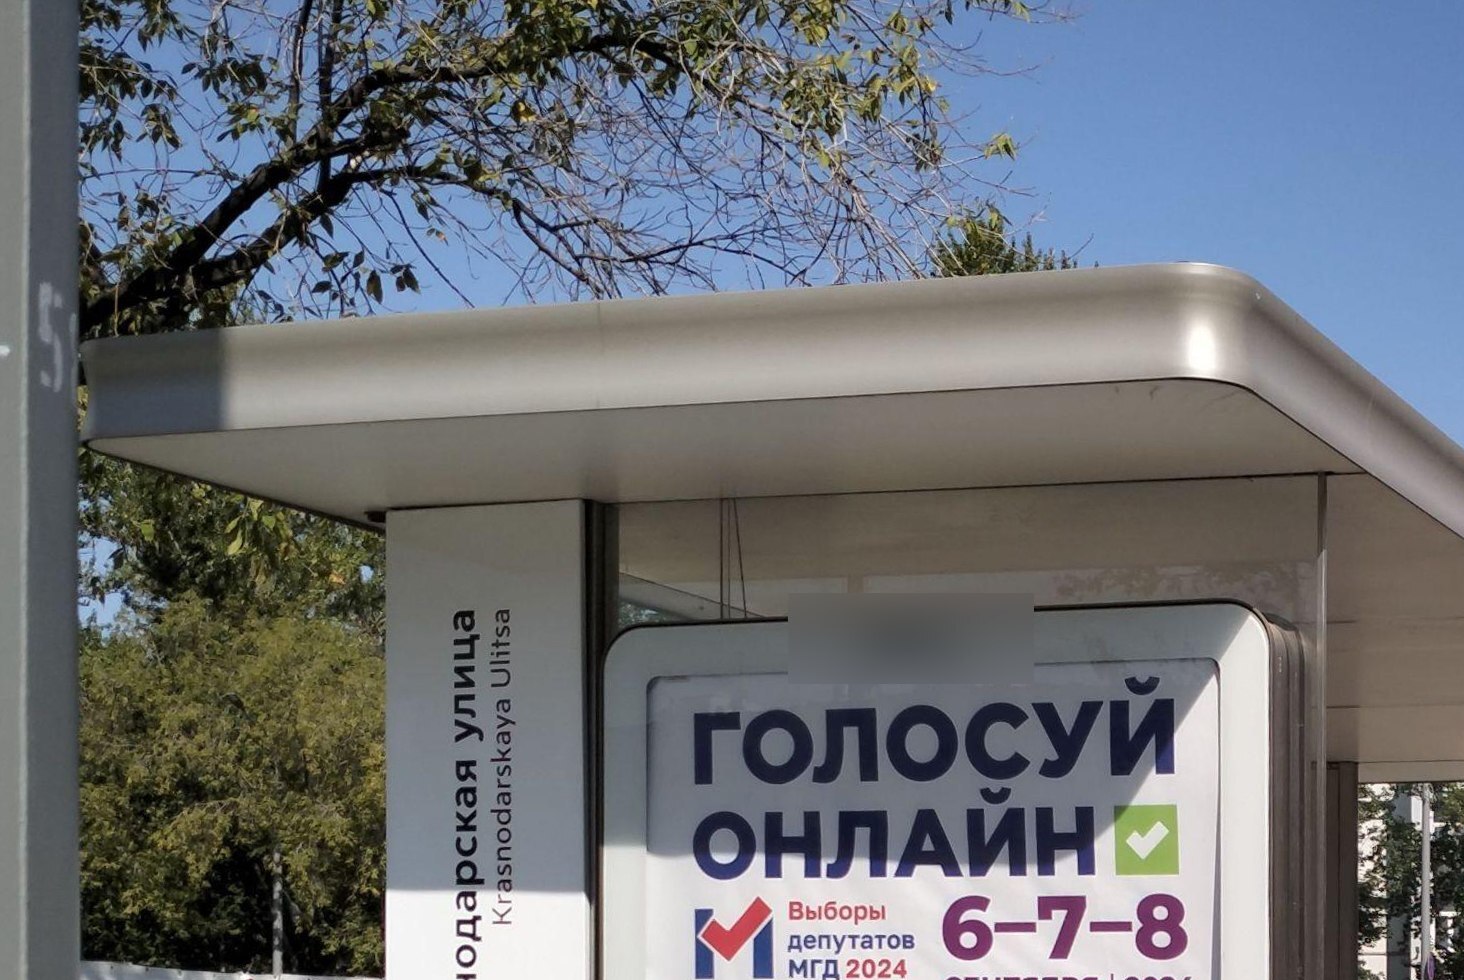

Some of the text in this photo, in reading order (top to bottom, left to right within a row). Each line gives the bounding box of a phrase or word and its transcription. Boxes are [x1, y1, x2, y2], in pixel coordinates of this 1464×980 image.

[453, 609, 484, 743] улица
[490, 608, 517, 926] Krasnodarskaya Ulitsa
[693, 676, 1177, 785] ГОЛОСУЙ
[692, 786, 1096, 880] ОНЛАЙН
[788, 901, 887, 925] Выборы
[788, 932, 915, 953] депутатов
[845, 958, 907, 980] 2024
